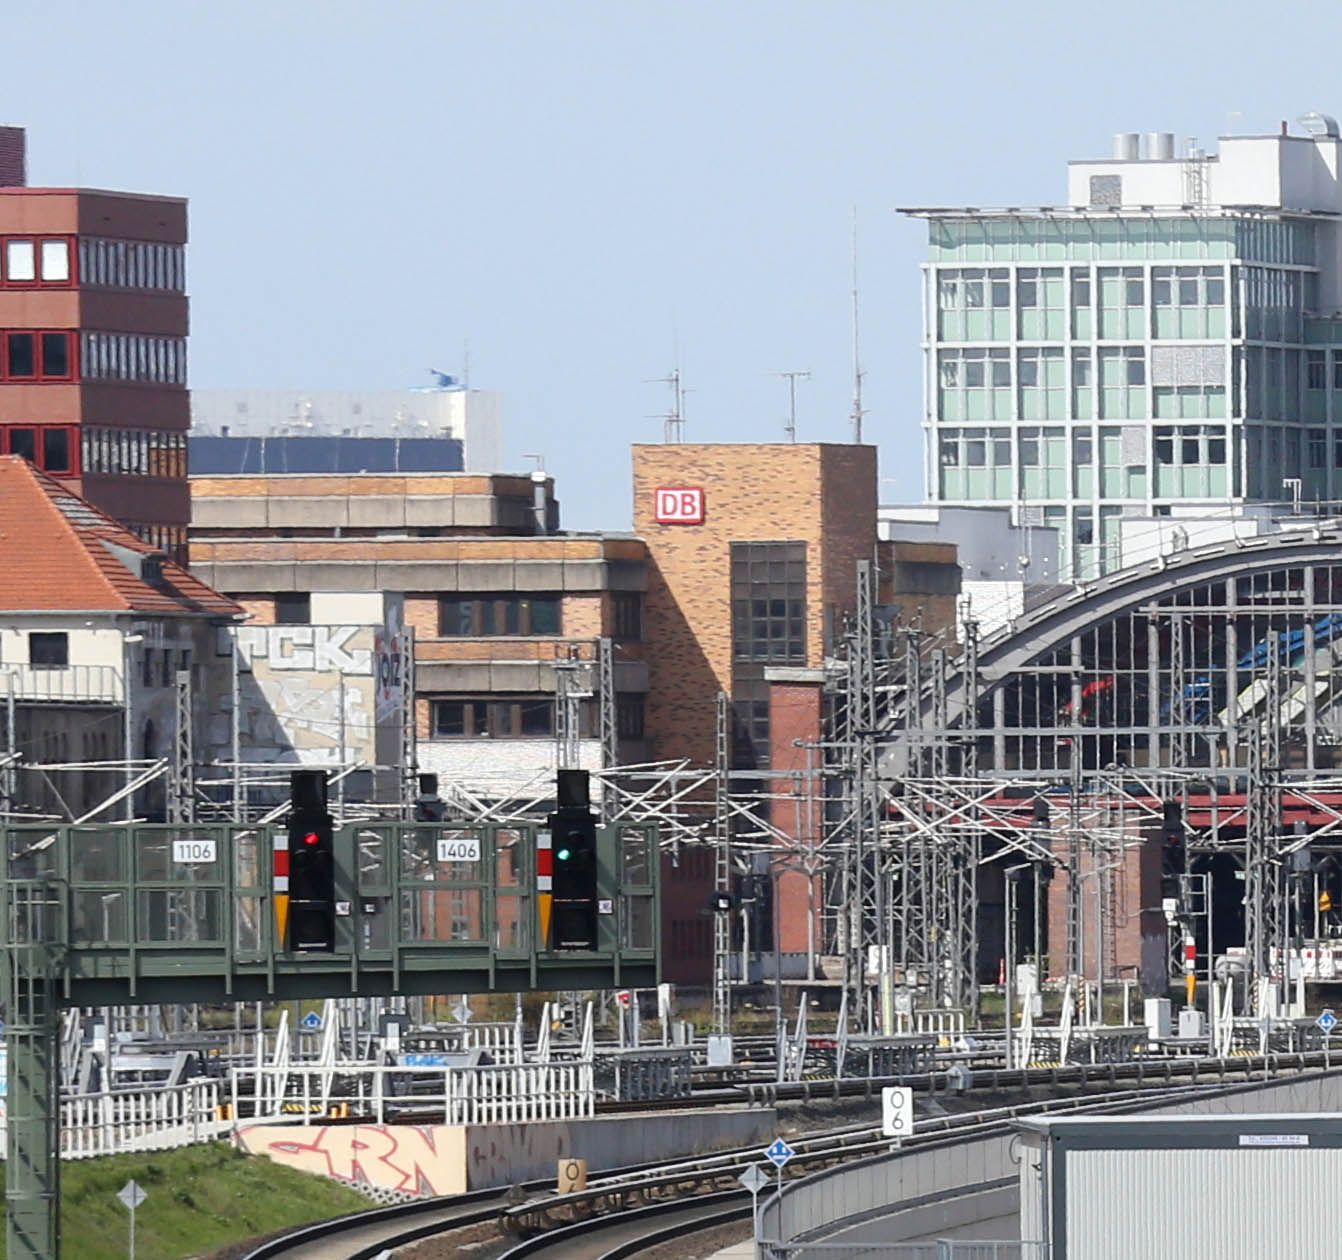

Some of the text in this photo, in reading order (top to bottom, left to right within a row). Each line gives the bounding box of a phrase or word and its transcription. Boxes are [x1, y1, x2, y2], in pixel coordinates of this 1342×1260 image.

[662, 493, 696, 516] DB
[179, 843, 212, 859] 1106
[440, 842, 477, 859] 1406
[890, 1090, 905, 1109] 0
[892, 1111, 904, 1130] 6
